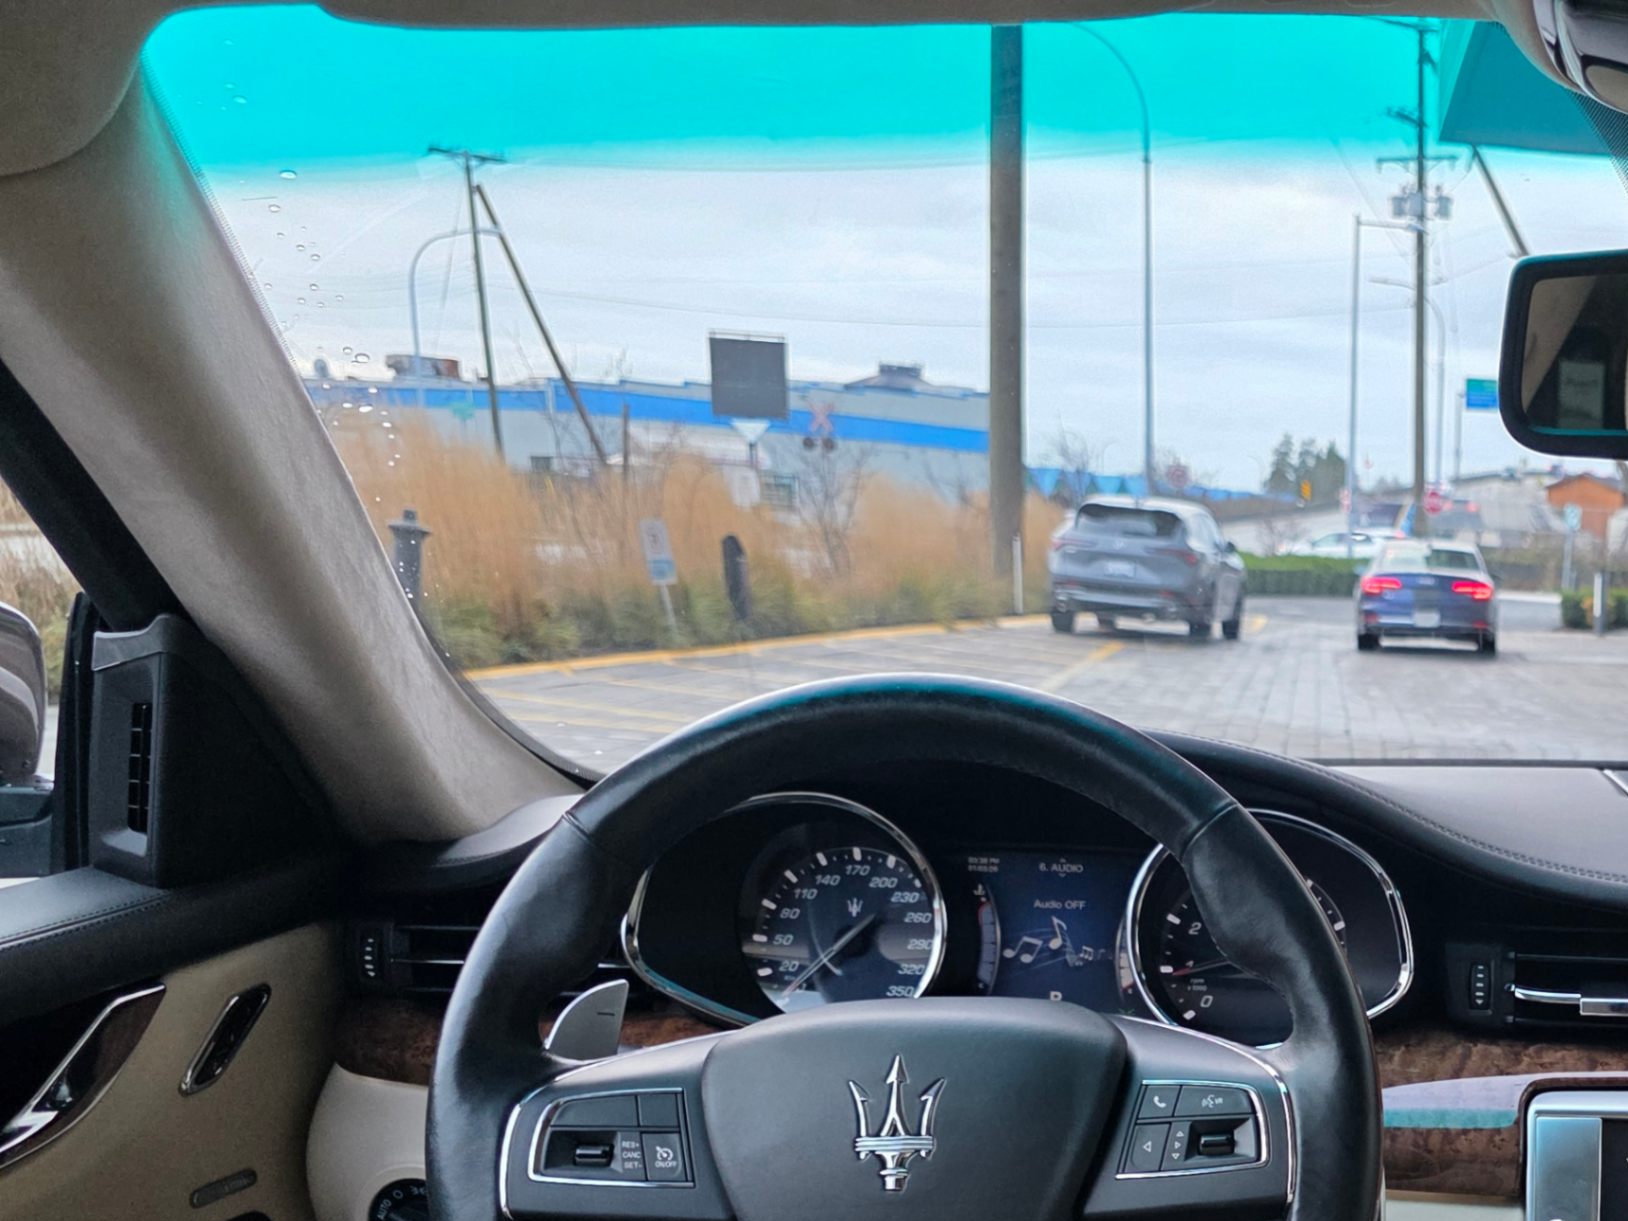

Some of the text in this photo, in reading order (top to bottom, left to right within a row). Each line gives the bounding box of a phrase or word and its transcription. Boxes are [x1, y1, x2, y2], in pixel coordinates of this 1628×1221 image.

[845, 864, 870, 876] 170
[1051, 863, 1084, 873] AUDIO
[815, 874, 840, 886] 140
[868, 877, 898, 888] 200
[794, 888, 818, 900] 110
[890, 892, 920, 903] 230
[1033, 899, 1087, 910] Audio OFF
[780, 908, 800, 920] 80
[904, 912, 932, 924] 260
[1188, 922, 1201, 935] 2
[772, 934, 794, 946] 50
[907, 938, 933, 950] 290
[779, 960, 799, 972] 20
[898, 964, 925, 976] 320
[886, 986, 914, 997] 350
[1200, 994, 1214, 1008] 0
[376, 1198, 392, 1220] AUTO
